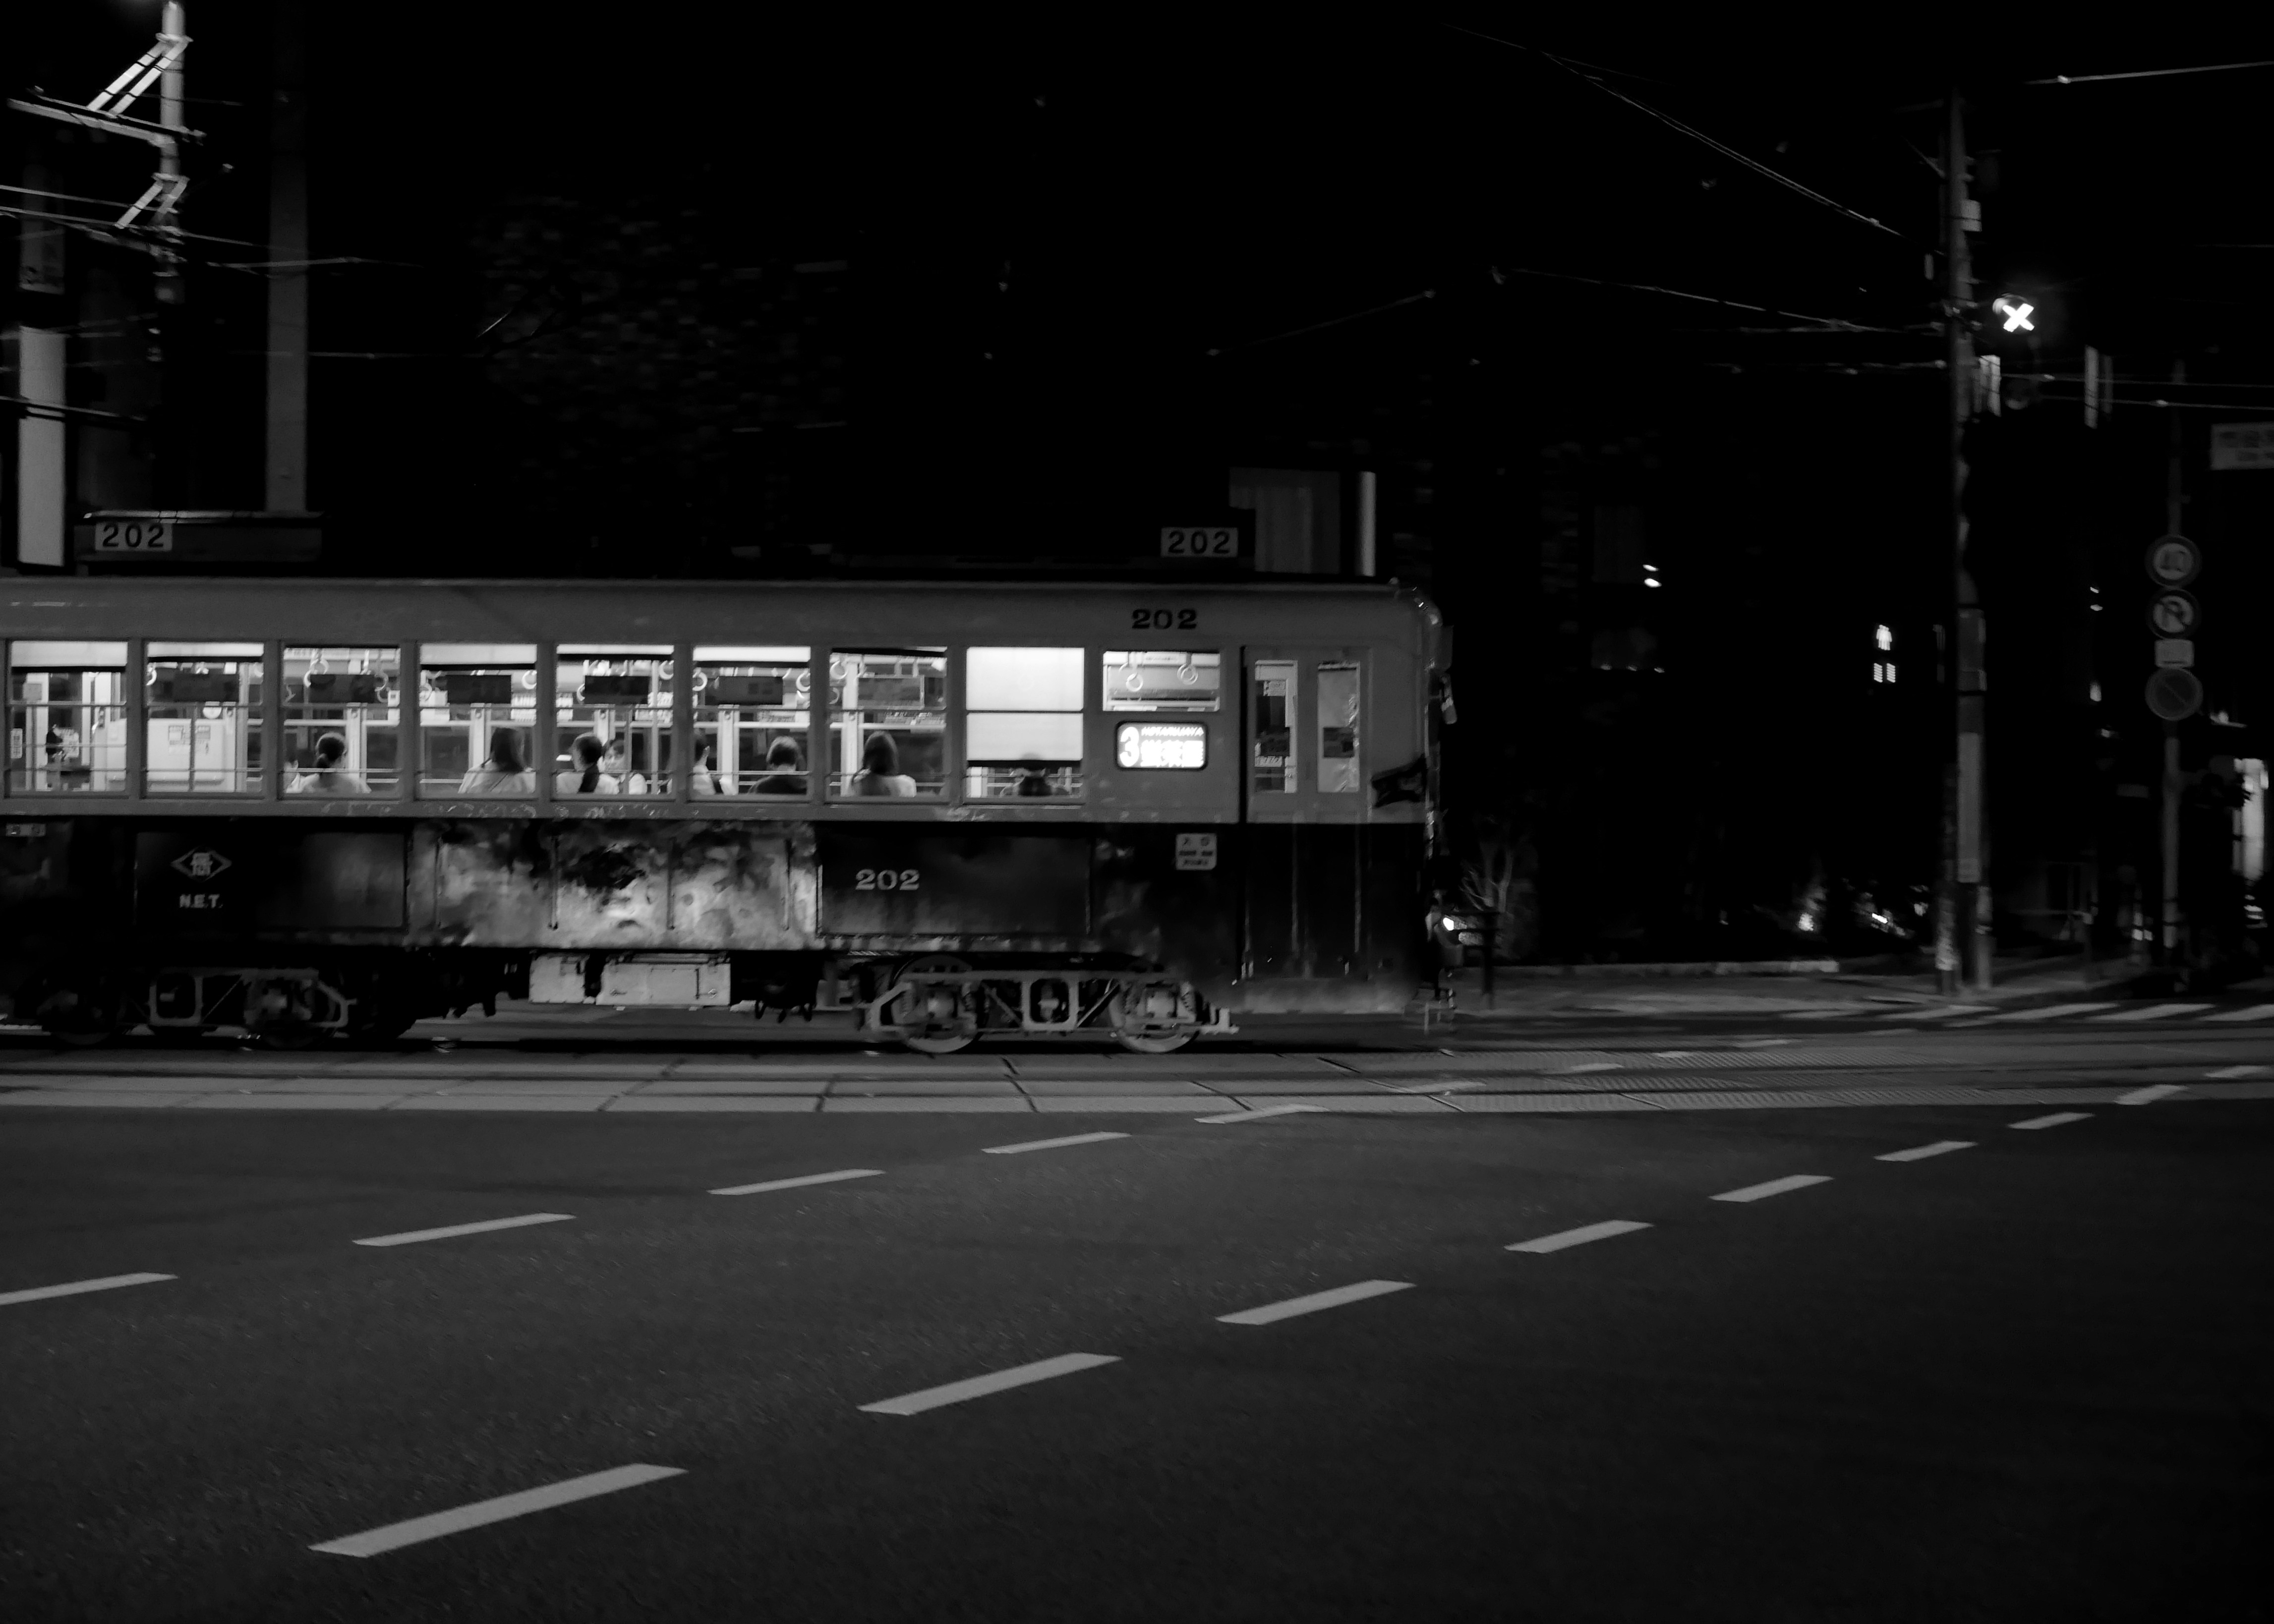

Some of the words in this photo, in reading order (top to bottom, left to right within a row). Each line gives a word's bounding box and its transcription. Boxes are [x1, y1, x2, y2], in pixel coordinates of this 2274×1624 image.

[103, 524, 163, 547] 202
[1168, 530, 1229, 554] 202
[1132, 609, 1196, 629] 202
[1119, 727, 1140, 767] 3
[855, 869, 920, 890] 202
